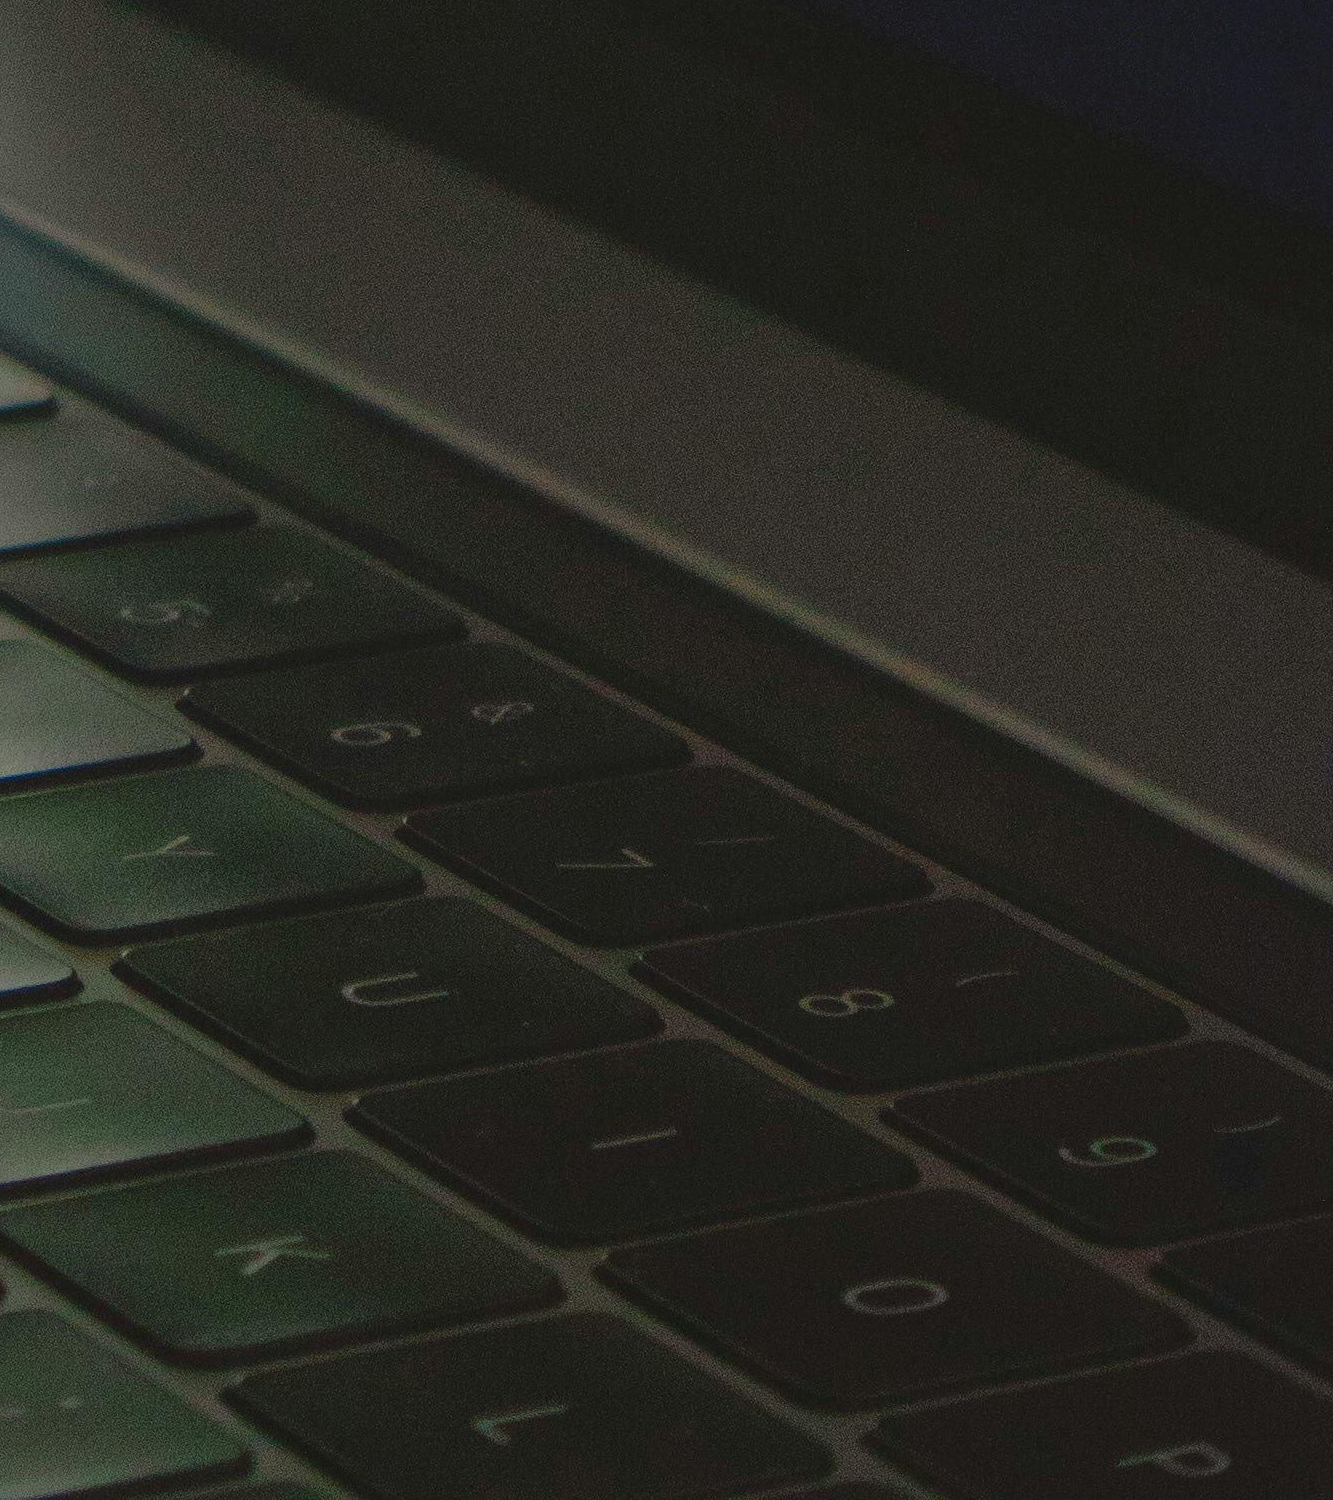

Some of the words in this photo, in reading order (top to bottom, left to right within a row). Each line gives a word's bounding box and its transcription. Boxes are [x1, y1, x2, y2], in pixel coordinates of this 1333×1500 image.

[117, 596, 211, 628] 5
[330, 720, 425, 749] 6
[121, 832, 217, 862] Y
[554, 844, 658, 871] 7
[337, 968, 453, 1009] U
[794, 983, 898, 1020] 8
[1055, 1132, 1162, 1171] 9
[213, 1231, 332, 1277] K
[468, 1402, 572, 1448] L
[1112, 1440, 1234, 1479] P
